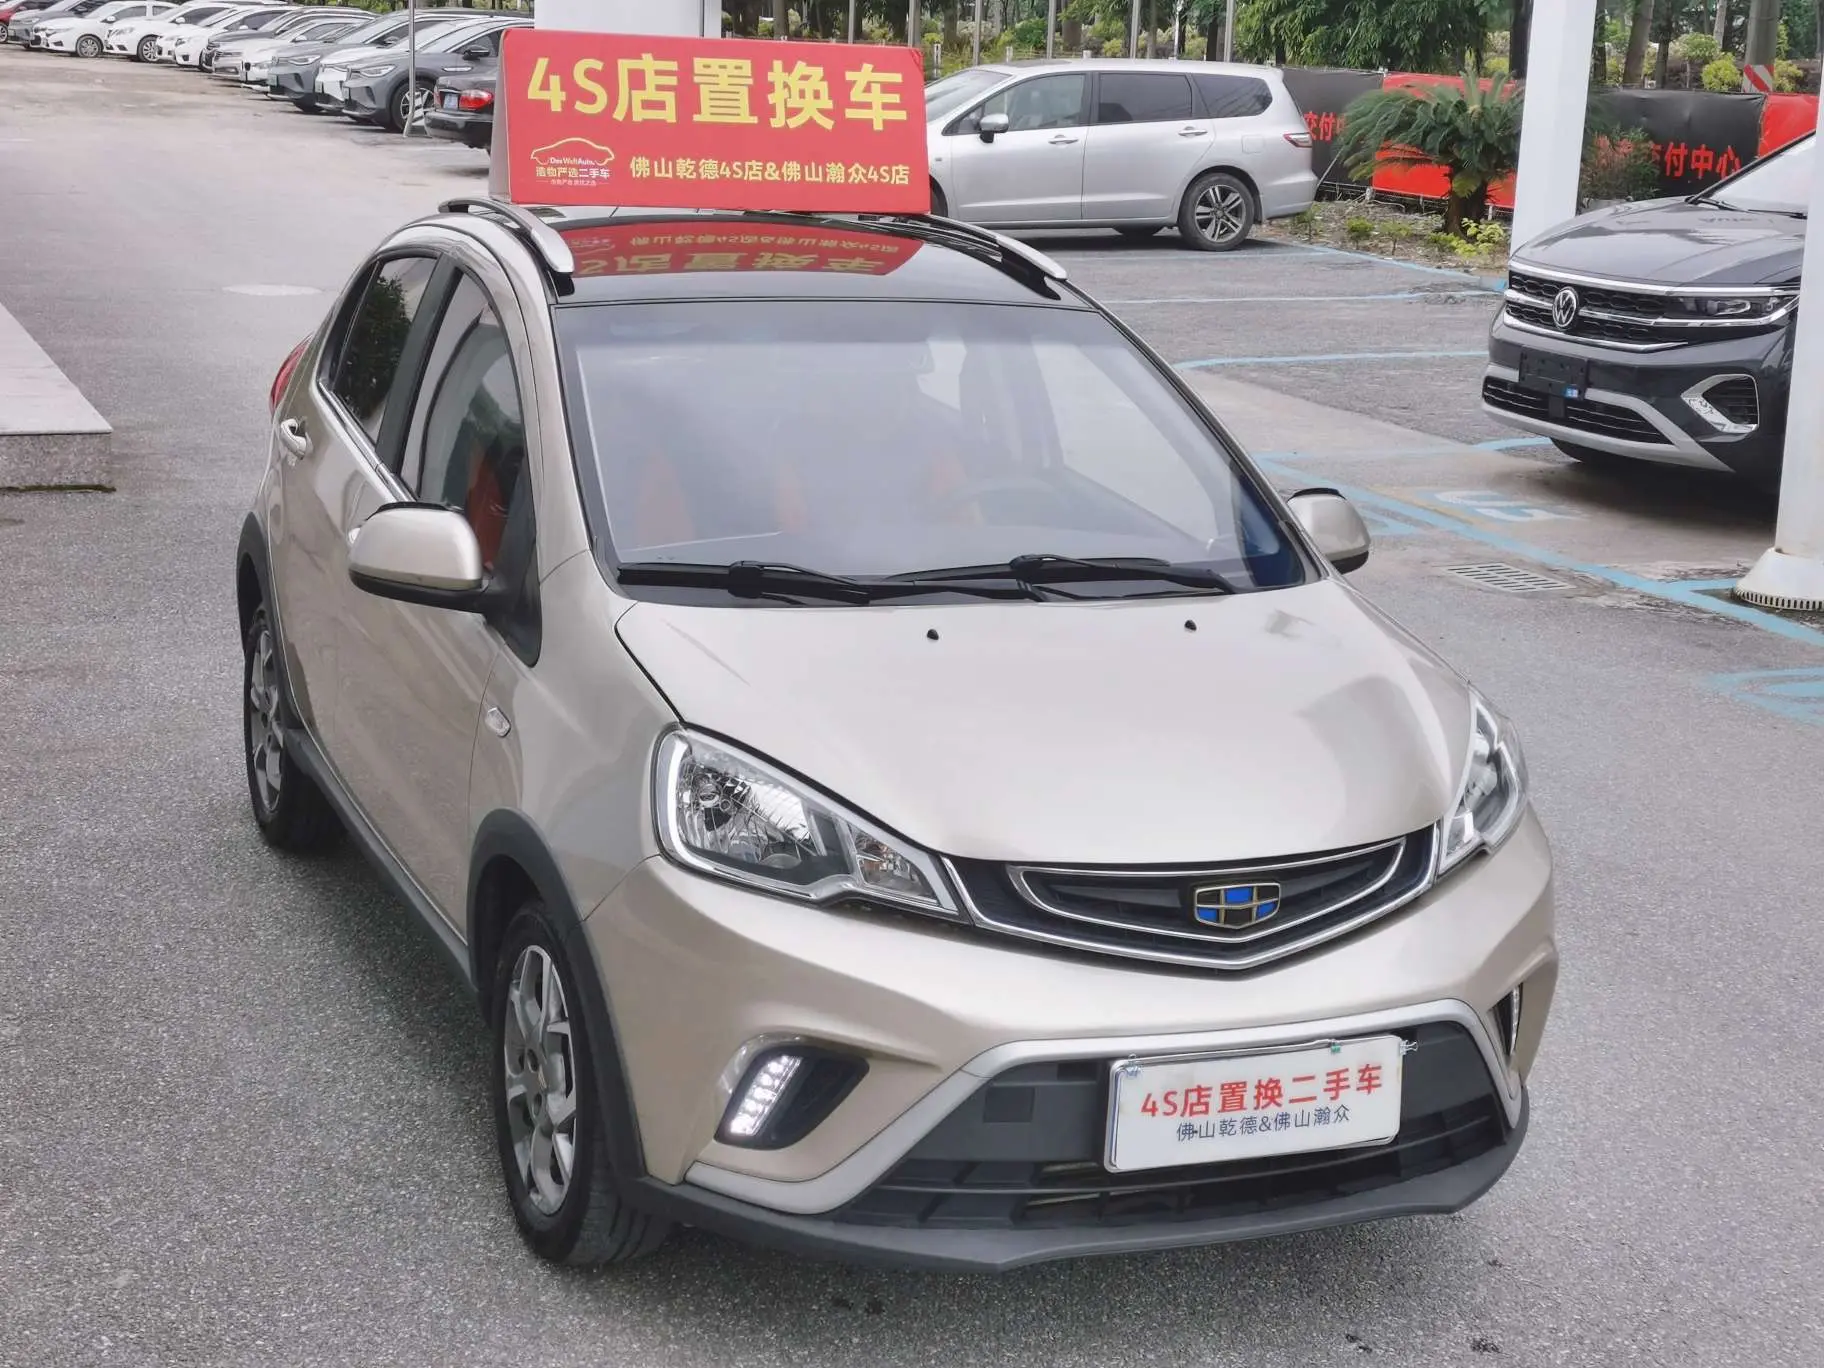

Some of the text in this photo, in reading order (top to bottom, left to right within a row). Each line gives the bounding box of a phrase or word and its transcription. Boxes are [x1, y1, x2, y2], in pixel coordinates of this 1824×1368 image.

[527, 53, 908, 131] 4S店置换车
[629, 155, 910, 186] 佛山乾德4S店&佛山瀚众4S店
[1140, 1063, 1382, 1118] 4S店置换二手车
[1176, 1104, 1351, 1142] 佛山乾德&佛山瀚众
